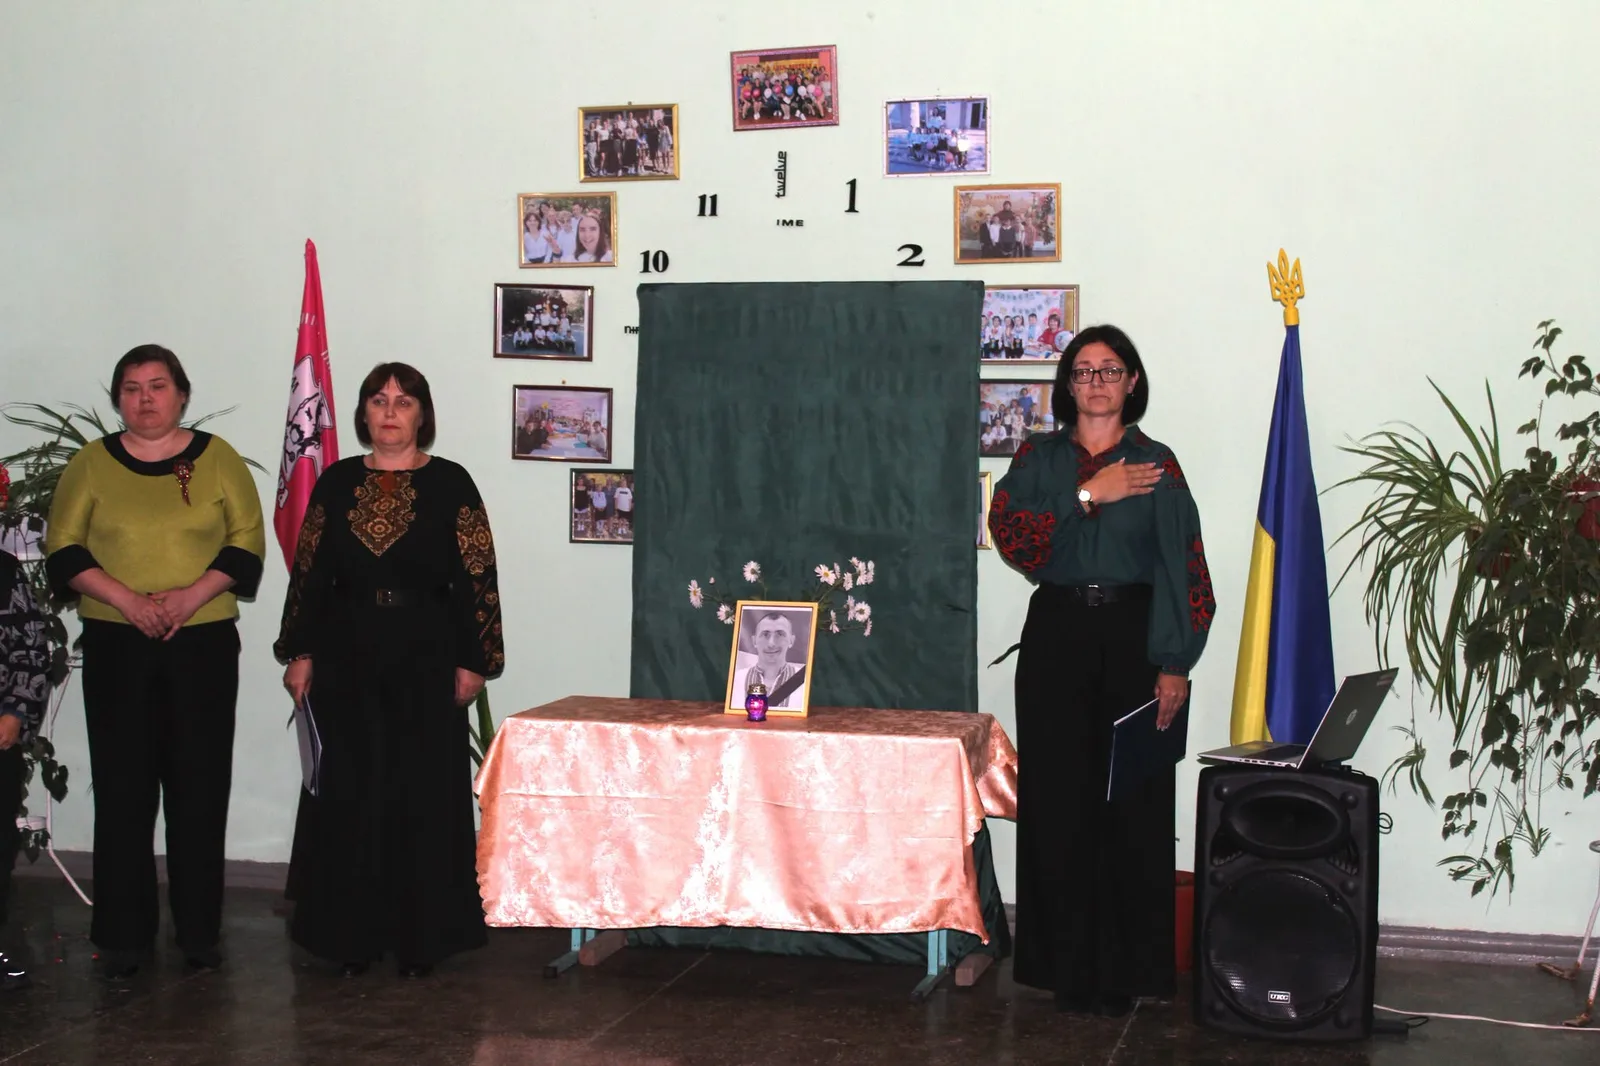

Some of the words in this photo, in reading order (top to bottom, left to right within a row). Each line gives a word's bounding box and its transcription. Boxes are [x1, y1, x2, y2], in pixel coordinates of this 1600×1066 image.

[775, 151, 787, 198] twelve
[697, 194, 717, 216] 11
[845, 179, 859, 213] 1
[640, 250, 669, 273] 10
[897, 244, 925, 267] 2
